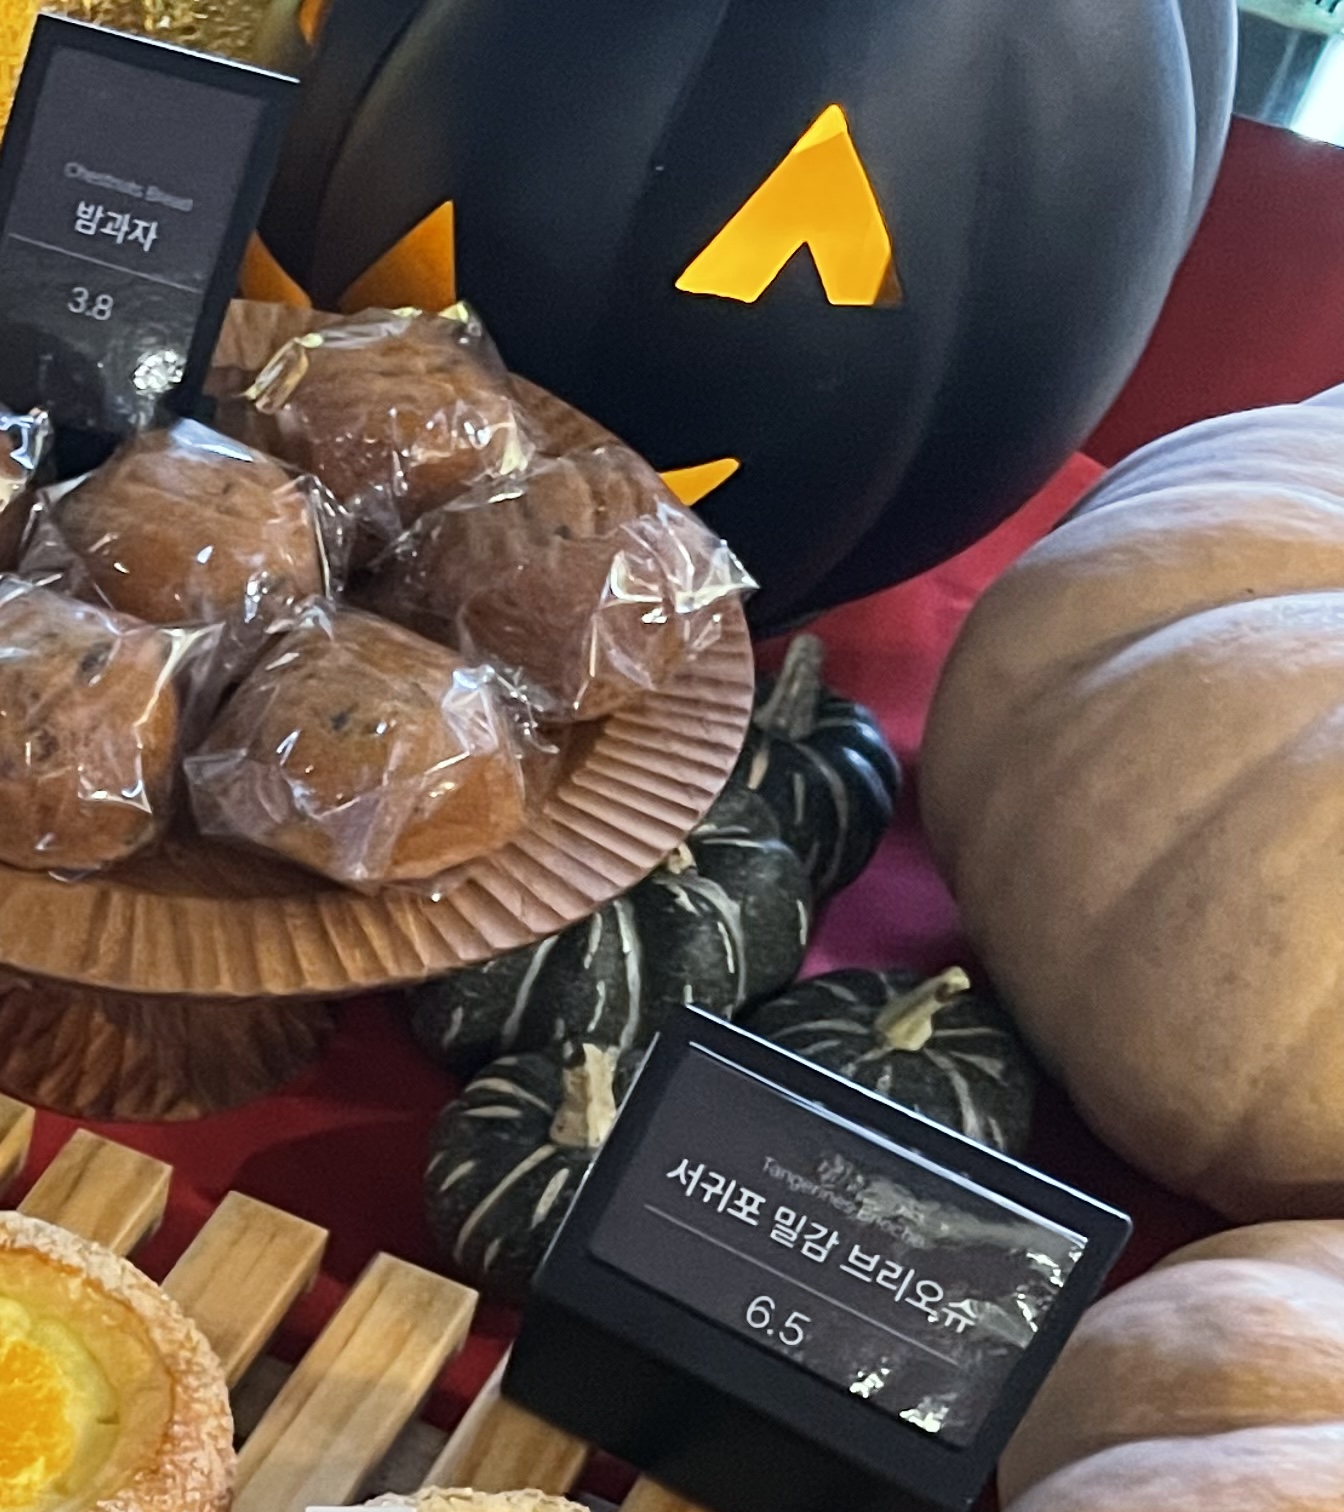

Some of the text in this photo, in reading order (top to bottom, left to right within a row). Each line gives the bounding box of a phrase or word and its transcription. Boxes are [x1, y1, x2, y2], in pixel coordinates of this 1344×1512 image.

[74, 201, 159, 252] 밤과자
[67, 287, 114, 321] 3.8
[666, 1158, 977, 1333] 서귀포 밀감 브리오슈
[744, 1295, 811, 1346] 6.5
